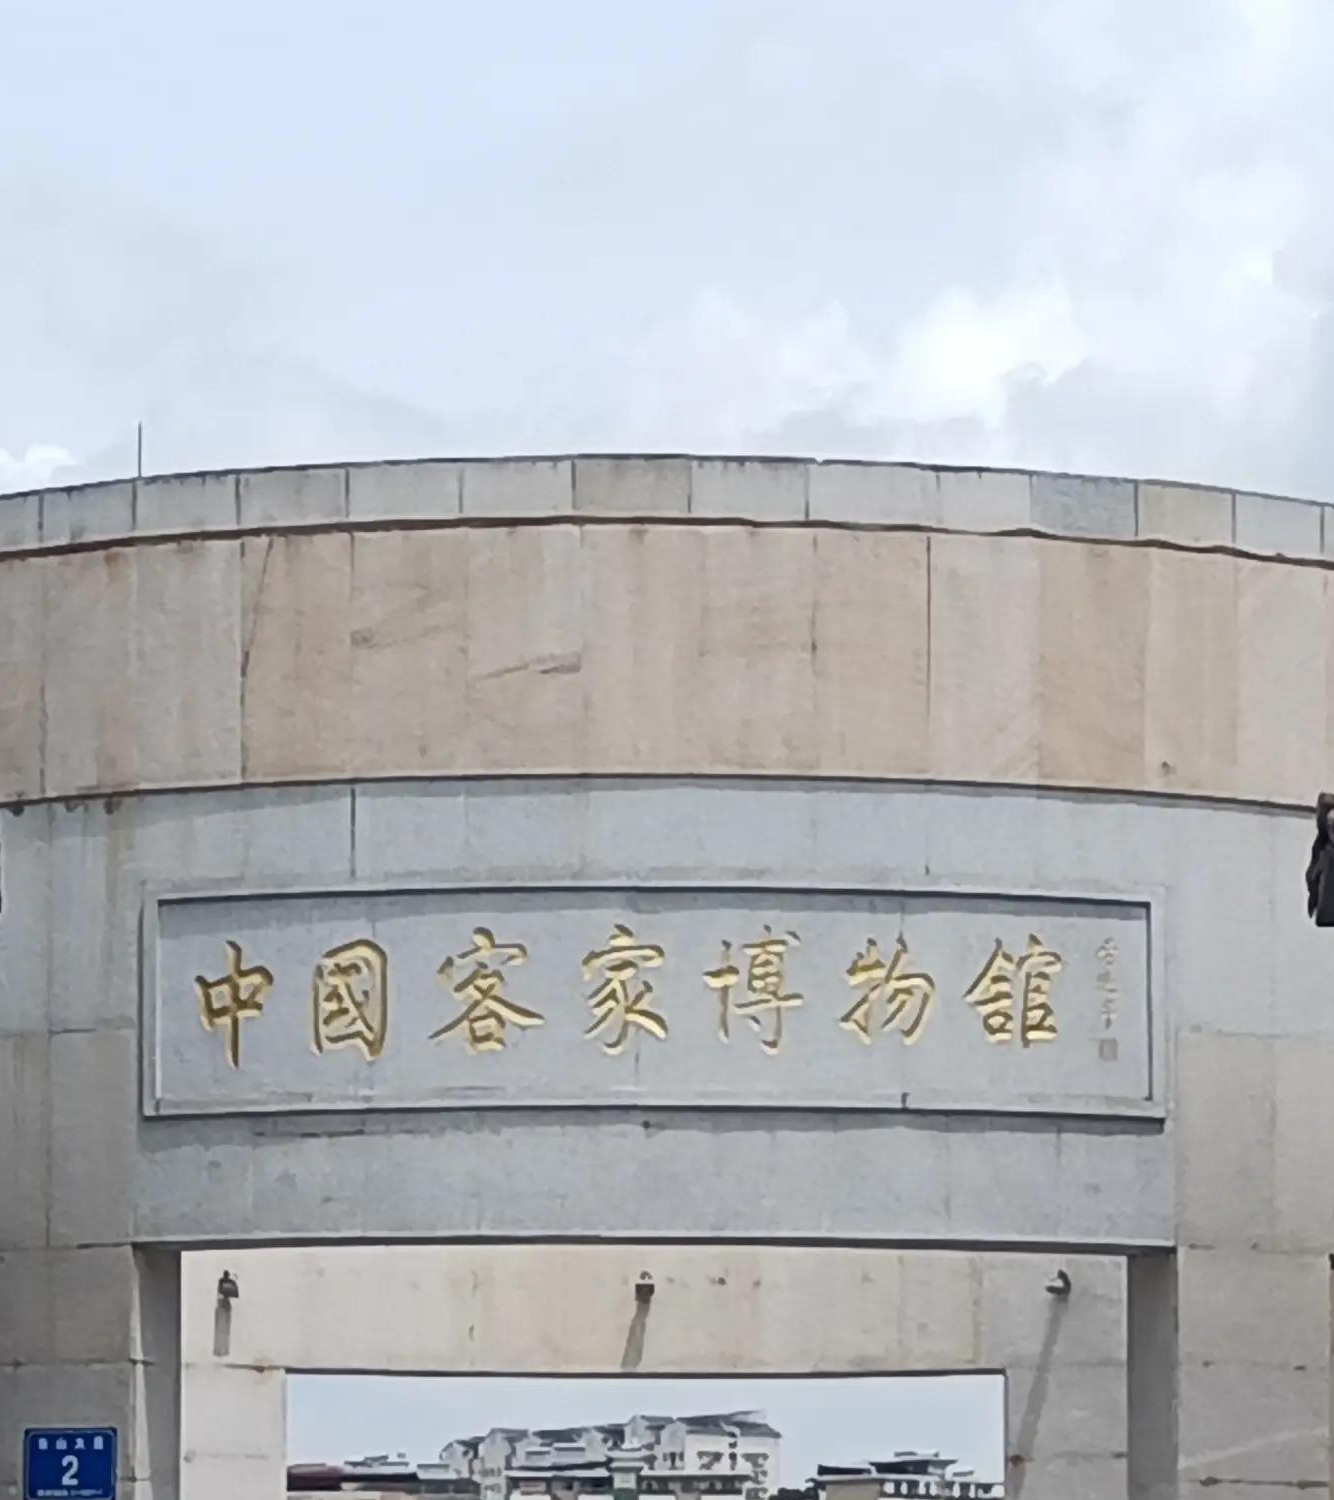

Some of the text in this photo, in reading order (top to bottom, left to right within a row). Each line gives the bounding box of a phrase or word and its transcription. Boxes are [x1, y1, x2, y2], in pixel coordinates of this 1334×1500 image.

[194, 923, 1063, 1069] 中國客家博物館
[61, 1455, 79, 1486] 2
